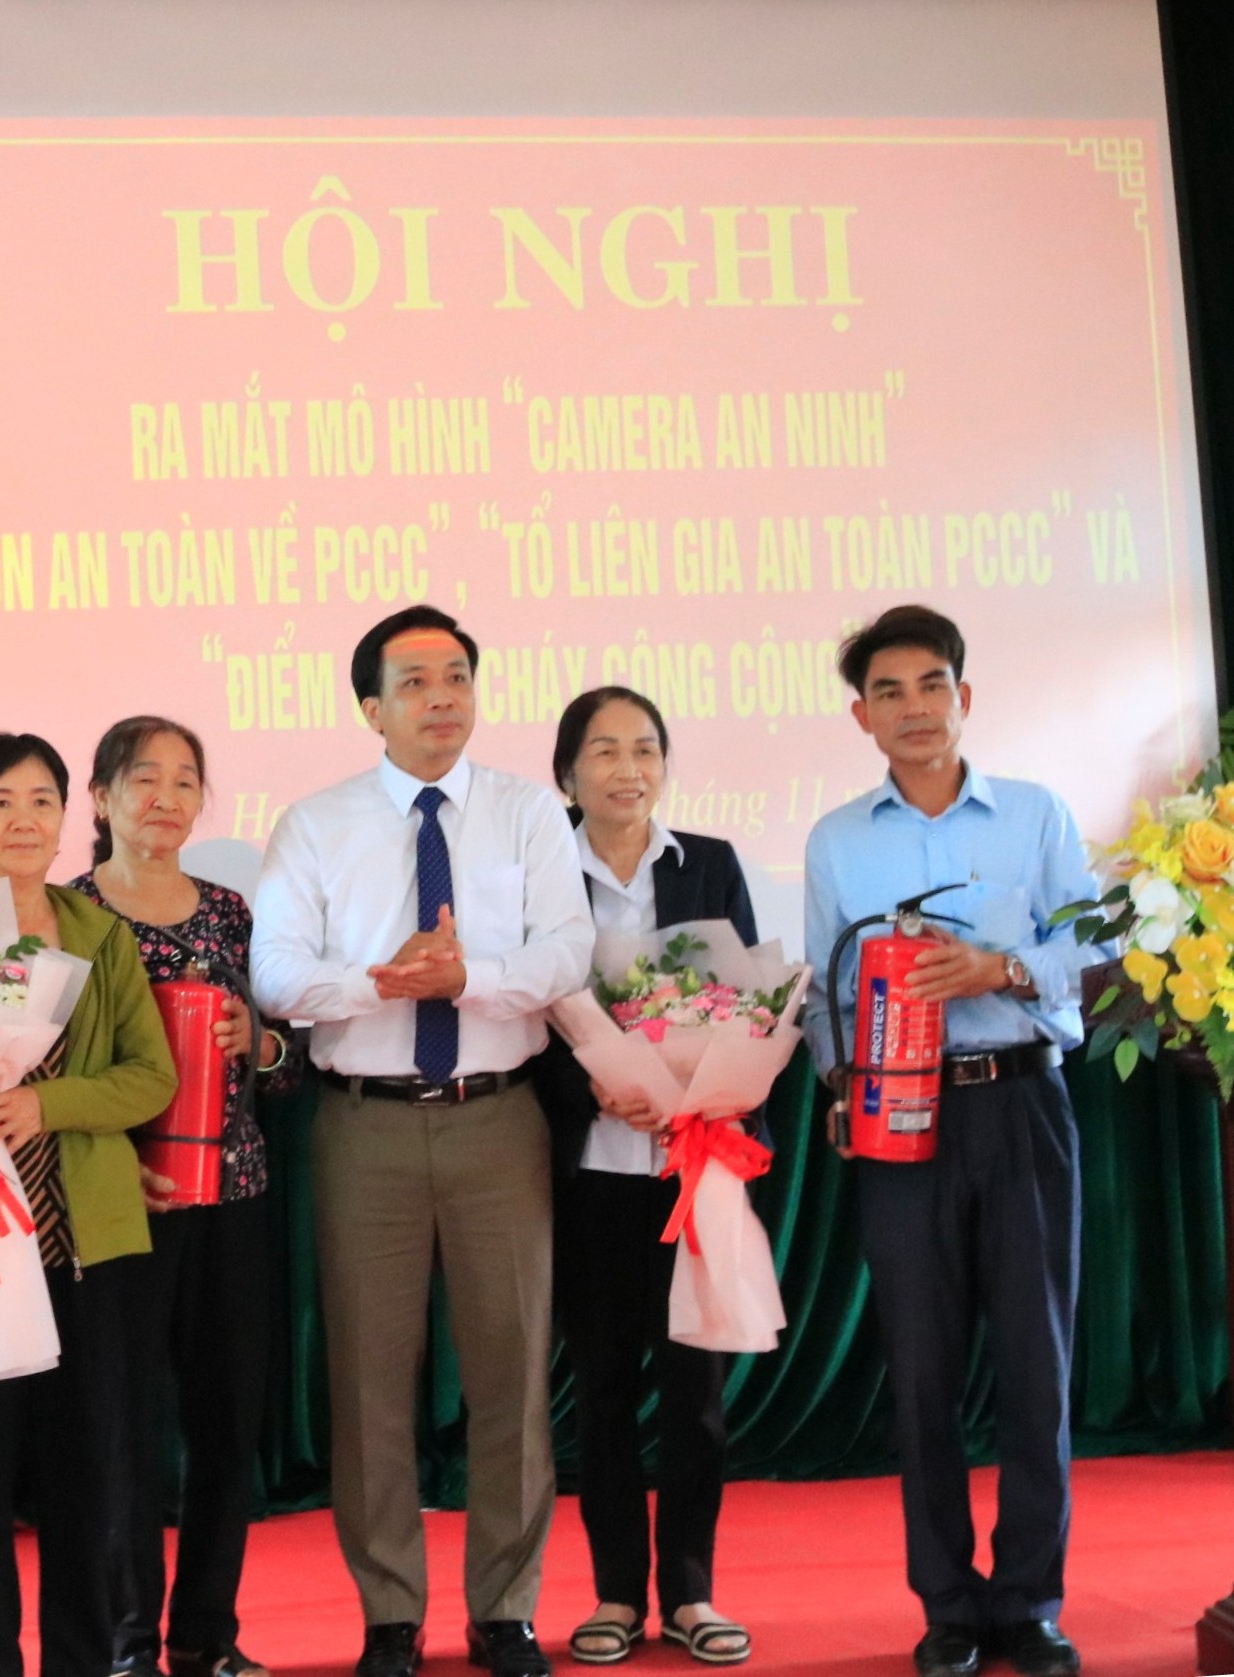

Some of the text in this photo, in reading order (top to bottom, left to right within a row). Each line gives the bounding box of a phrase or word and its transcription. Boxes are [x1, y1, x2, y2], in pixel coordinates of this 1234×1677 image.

[162, 175, 864, 342] HỘI NGHỊ
[131, 401, 189, 480] RA
[201, 371, 292, 479] MẮT
[306, 382, 375, 477] MÔ
[388, 381, 491, 476] HÌNH
[715, 393, 772, 470] AN
[49, 531, 108, 609] AN
[120, 512, 237, 608] TOÀN
[248, 500, 301, 605] VỀ
[567, 504, 660, 597] LIÊN
[672, 518, 743, 595] GIA
[756, 516, 812, 593] AN
[823, 498, 932, 591] TOÀN
[1085, 493, 1141, 584] VÀ
[478, 630, 587, 725] CHÁY
[784, 776, 826, 824] 11
[871, 994, 886, 1065] PROTECT
